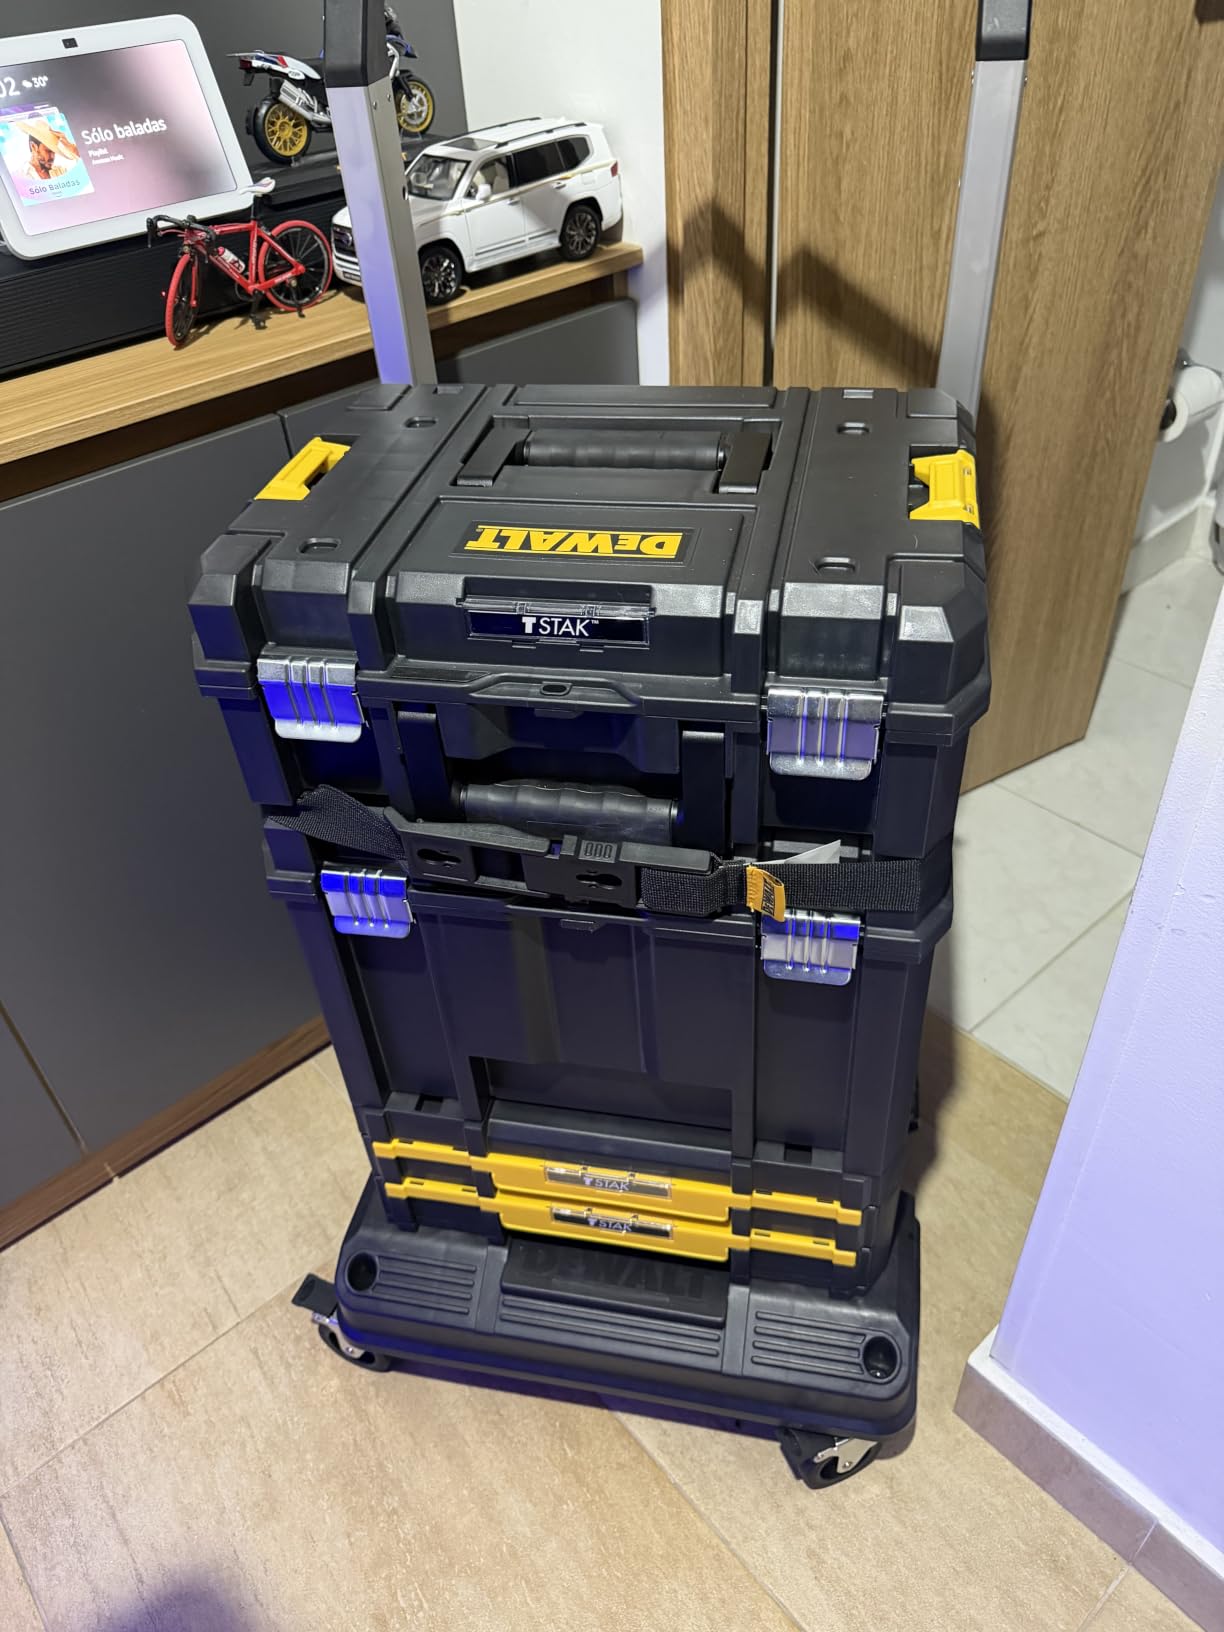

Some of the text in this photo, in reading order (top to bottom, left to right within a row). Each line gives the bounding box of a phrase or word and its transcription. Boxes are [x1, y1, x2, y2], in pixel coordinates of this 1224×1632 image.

[81, 118, 168, 146] Sólo baladas
[48, 179, 81, 191] Baladas
[464, 525, 684, 559] DEWALT
